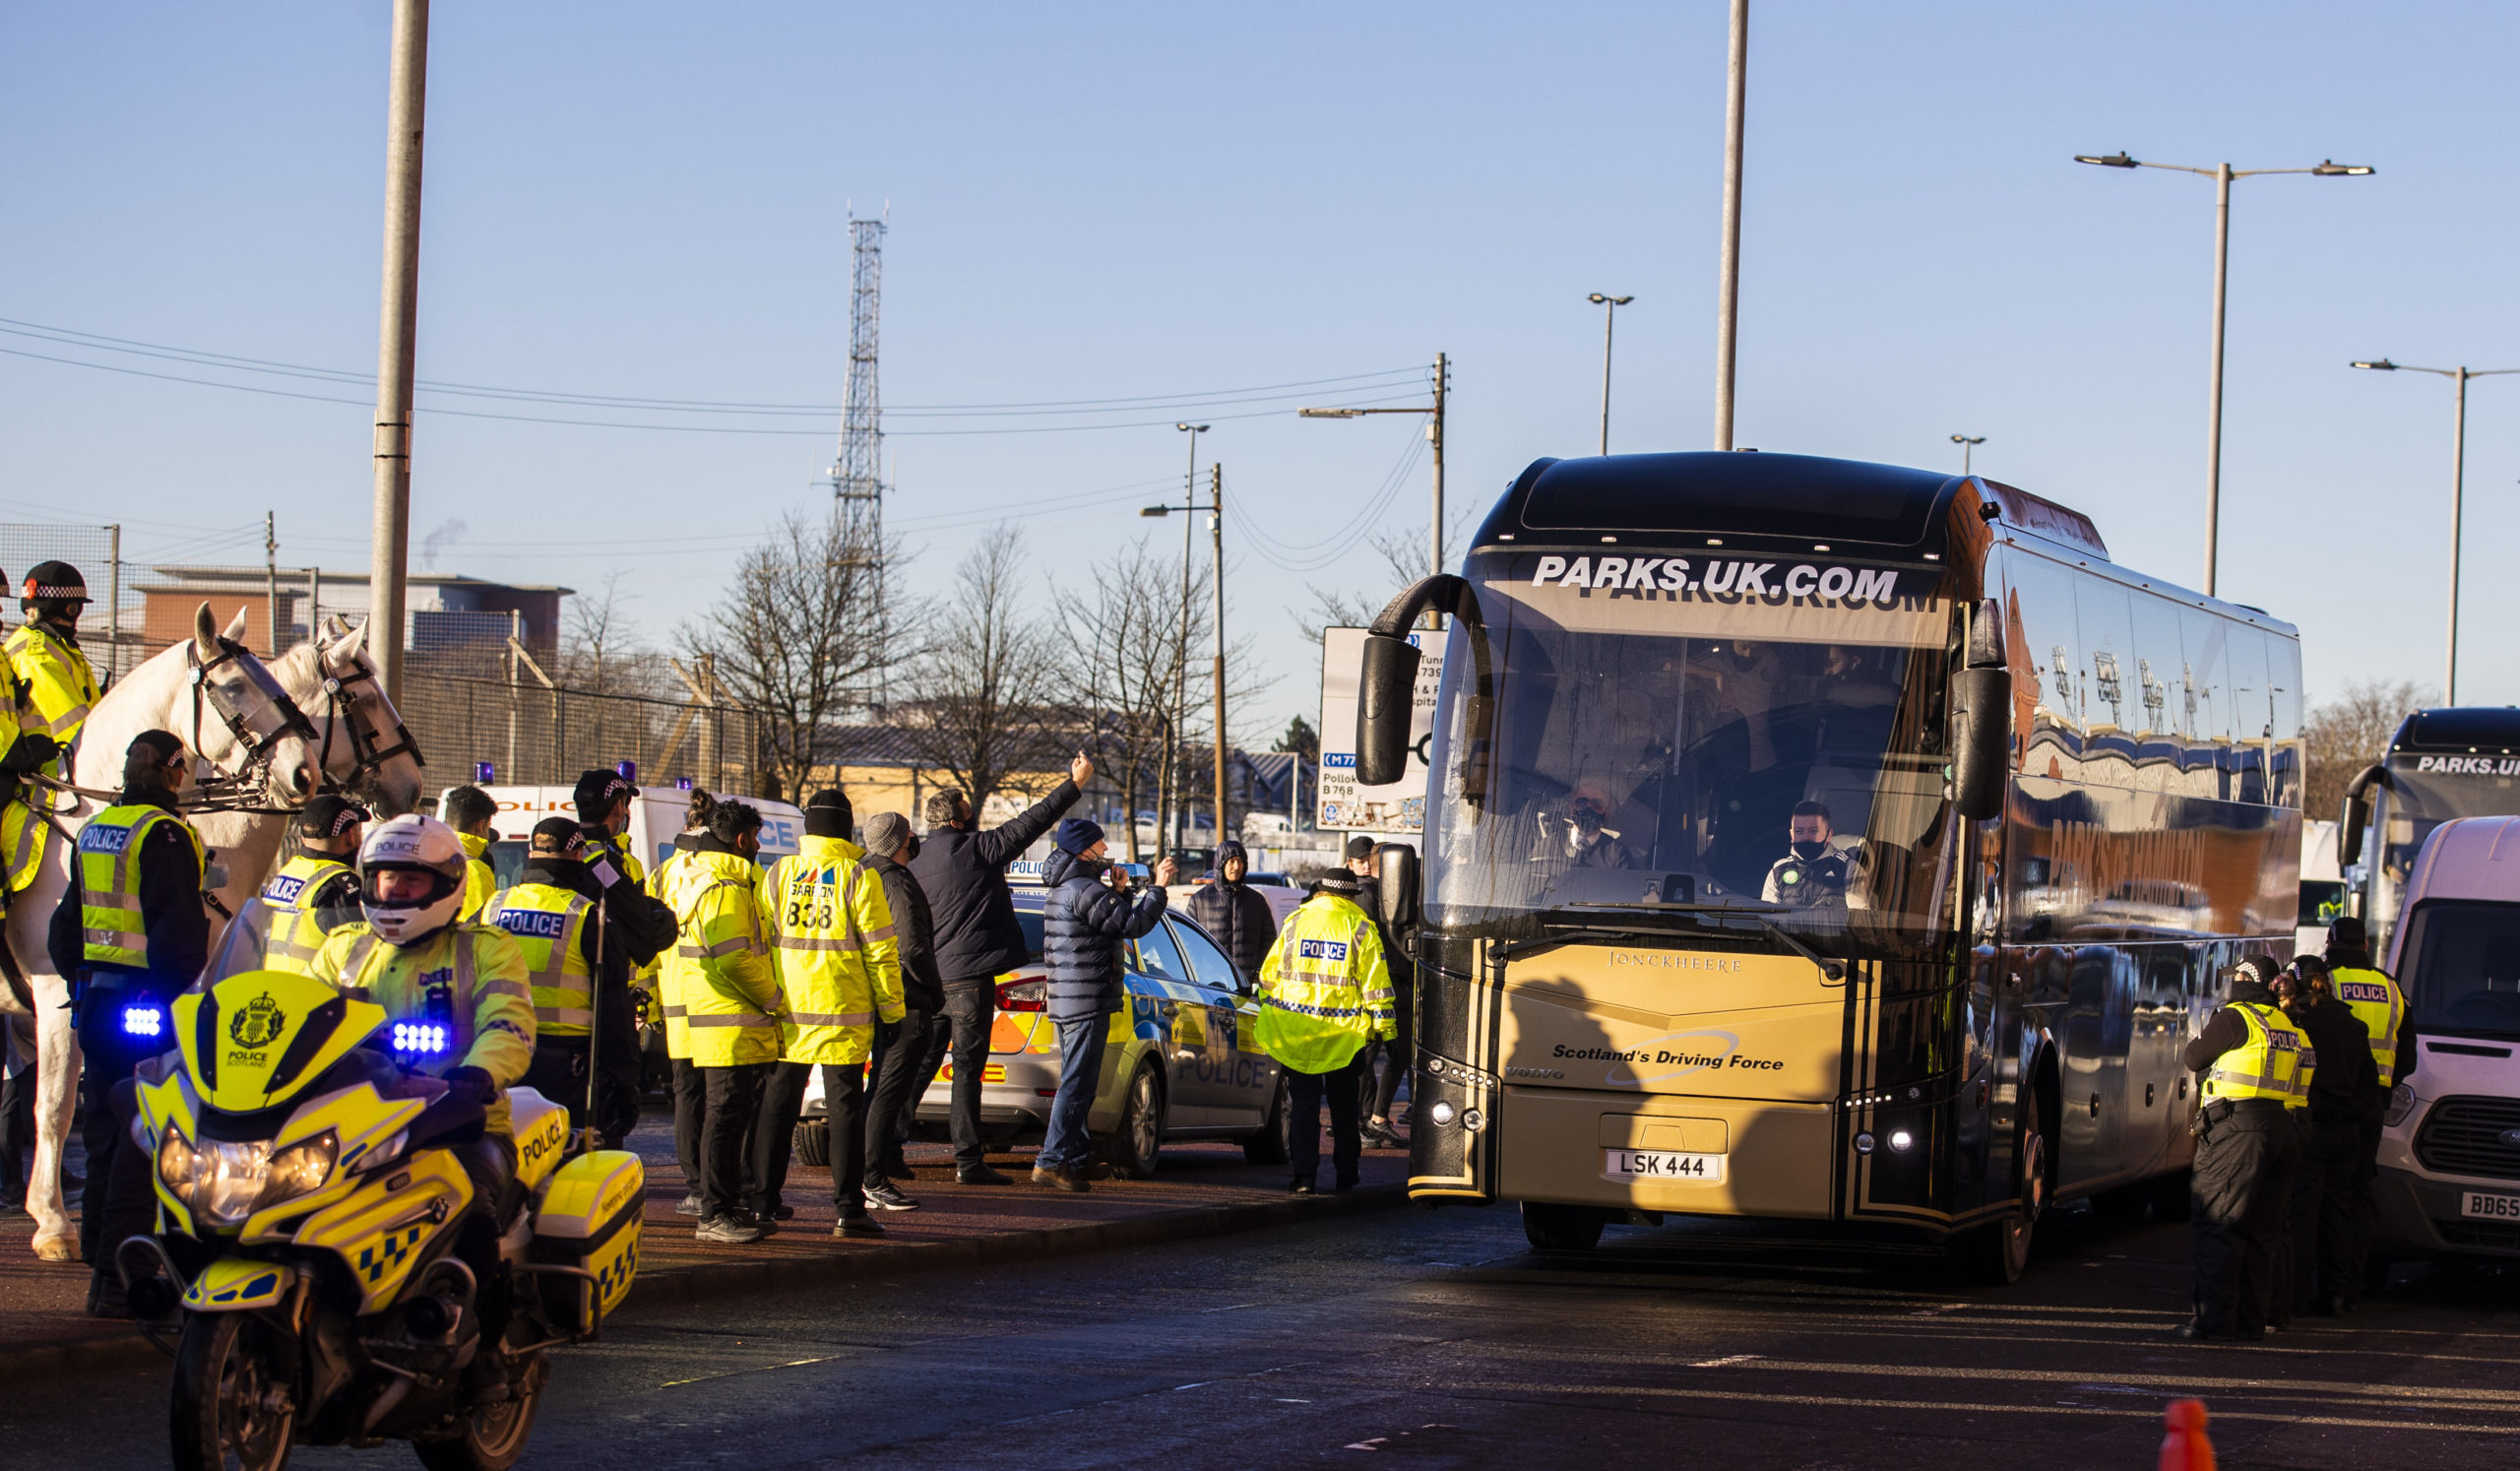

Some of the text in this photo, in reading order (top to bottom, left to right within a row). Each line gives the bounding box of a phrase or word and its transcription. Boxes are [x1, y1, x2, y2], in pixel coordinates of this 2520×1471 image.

[1532, 555, 1899, 602] PARKS.UK.COM
[81, 827, 127, 850] POLICE
[376, 841, 421, 856] POLICE
[1011, 861, 1044, 874] POLIC
[2130, 826, 2206, 907] HAMILTON
[266, 876, 302, 901] POLICE
[500, 912, 562, 935] POLICE
[787, 901, 833, 929] 838
[1606, 950, 1741, 973] JONCKHEERE
[2342, 984, 2388, 1000] POLICE
[229, 1051, 269, 1062] POLICE
[1552, 1044, 1785, 1071] Scotland's Driving Force
[1177, 1055, 1266, 1090] POLICE
[1505, 1066, 1565, 1080] VOLVO
[523, 1119, 562, 1167] POLICE
[1620, 1153, 1705, 1177] LSK 444
